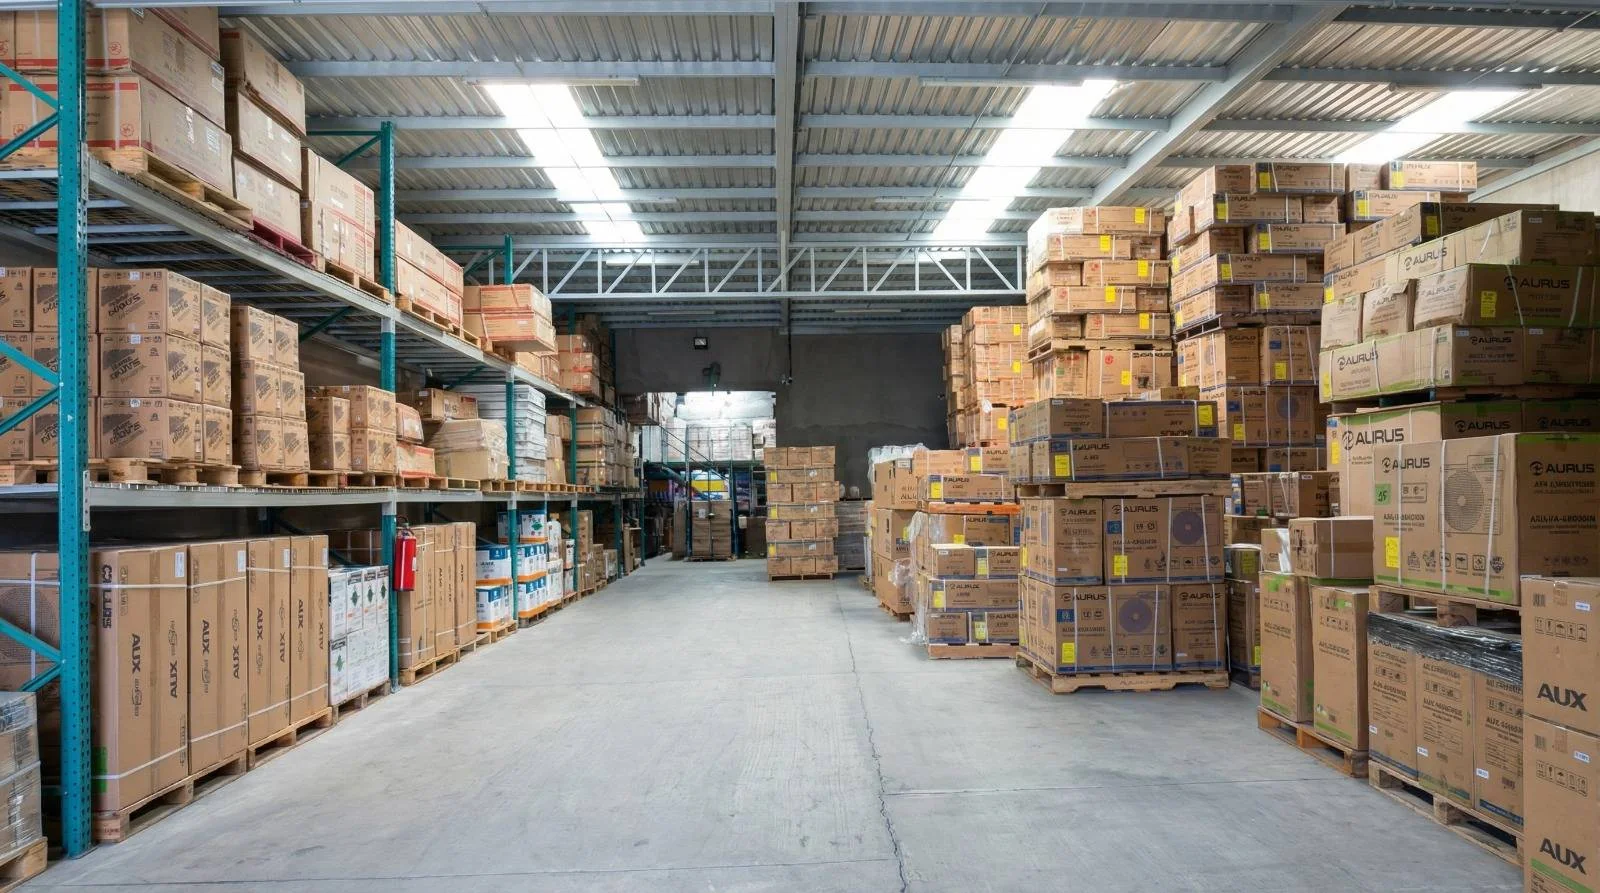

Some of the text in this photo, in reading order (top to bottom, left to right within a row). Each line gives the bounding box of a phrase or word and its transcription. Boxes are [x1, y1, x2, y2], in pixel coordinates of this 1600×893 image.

[1413, 247, 1448, 266] AURUS
[1520, 279, 1571, 289] AURUS
[1478, 336, 1512, 344] AURUS
[1344, 350, 1379, 367] AURUS
[1467, 421, 1512, 430] AURUS
[1355, 428, 1405, 445] AURUS
[1392, 457, 1431, 470] AURUS
[1545, 464, 1595, 473] AURUS
[1123, 505, 1159, 513] AURUS
[256, 608, 264, 641] AUX
[202, 620, 210, 655] AUX
[131, 633, 141, 673] AUX
[232, 644, 240, 680] AUX
[169, 660, 178, 699] AUX
[1536, 683, 1588, 712] AUX
[1539, 837, 1587, 875] AUX
